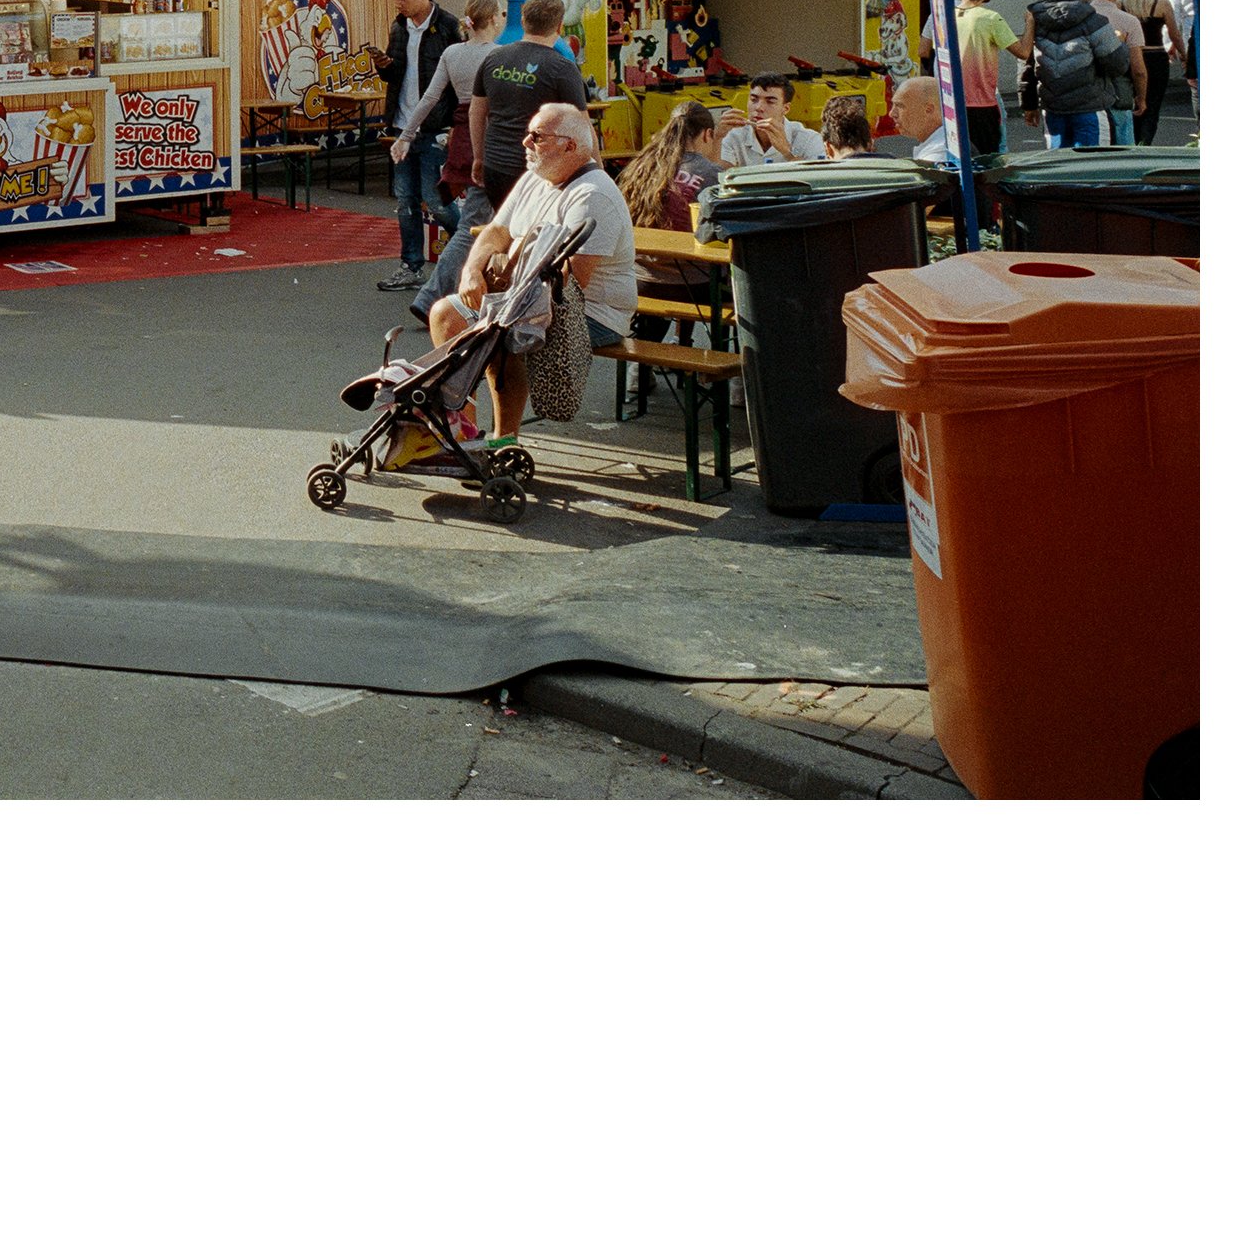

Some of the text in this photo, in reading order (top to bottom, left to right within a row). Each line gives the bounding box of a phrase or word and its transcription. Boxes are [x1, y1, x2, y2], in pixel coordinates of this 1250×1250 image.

[318, 44, 372, 87] Fried
[492, 64, 537, 85] dobro
[120, 92, 197, 122] We only
[115, 122, 199, 143] serve the
[139, 145, 215, 168] Chicken
